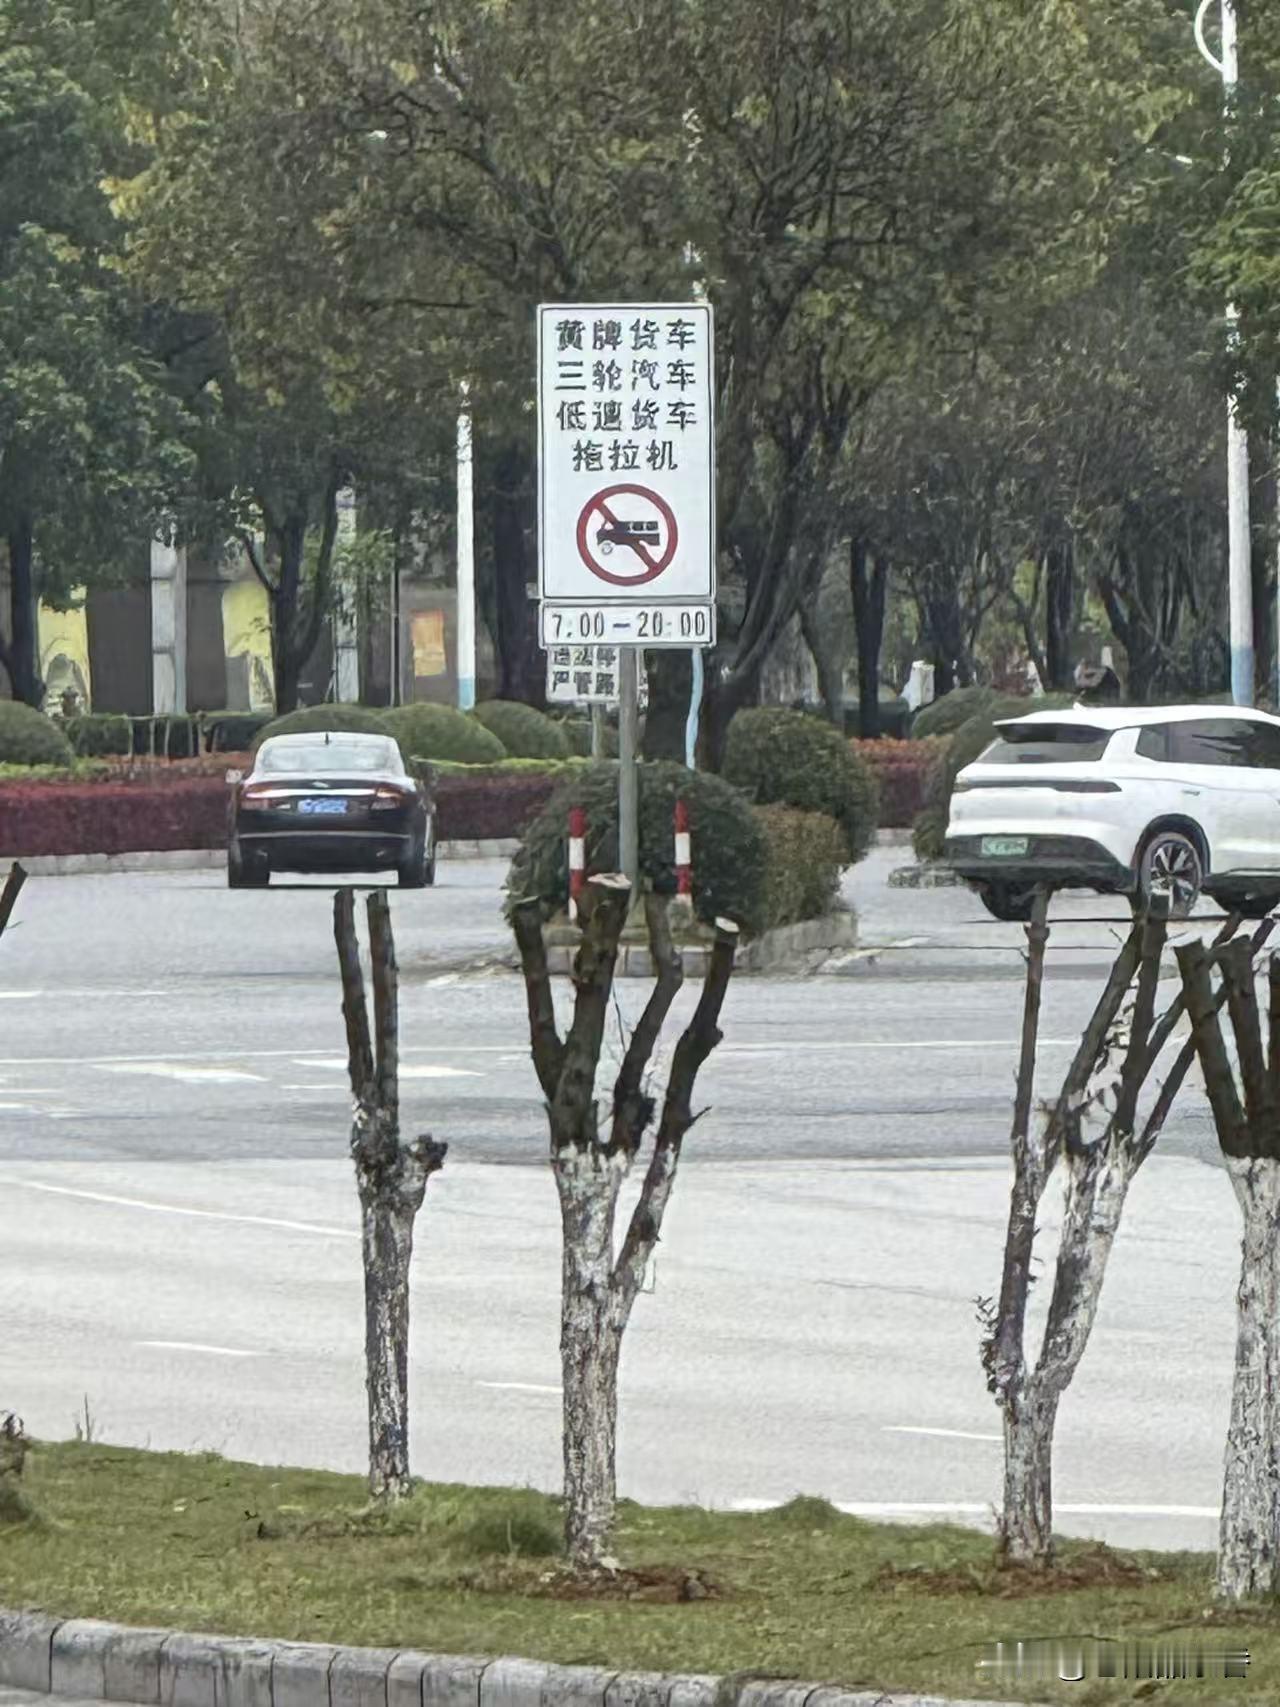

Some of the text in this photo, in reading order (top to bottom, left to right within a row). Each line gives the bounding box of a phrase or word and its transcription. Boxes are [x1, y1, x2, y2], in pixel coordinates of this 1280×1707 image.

[555, 318, 697, 351] 黄牌货车
[554, 358, 697, 391] 三轮汽车
[556, 398, 698, 431] 低速货车
[572, 438, 679, 472] 拖拉机
